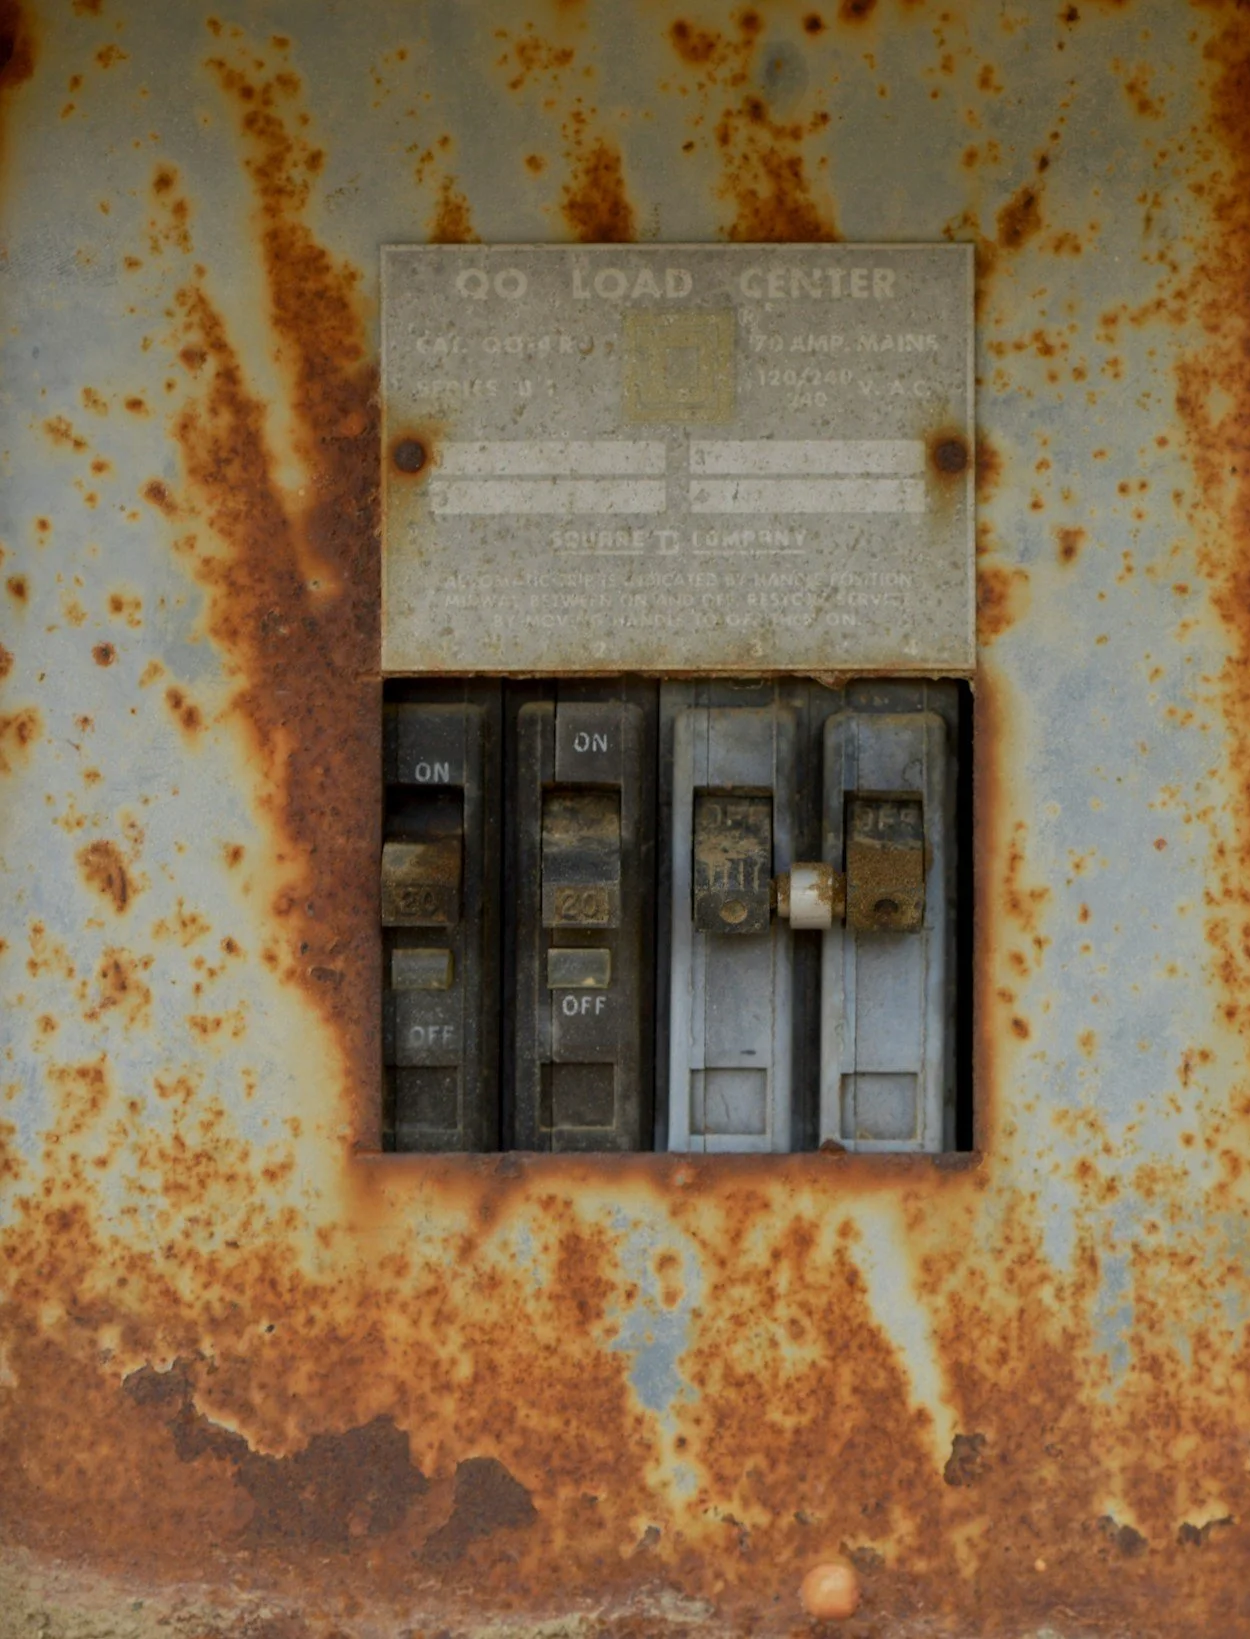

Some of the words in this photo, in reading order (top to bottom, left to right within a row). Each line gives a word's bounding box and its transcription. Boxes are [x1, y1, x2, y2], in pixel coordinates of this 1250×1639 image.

[456, 268, 529, 300] QO
[572, 268, 694, 300] LOAD
[739, 268, 897, 300] CENTER
[856, 334, 939, 353] MAINS
[549, 530, 645, 550] SQUARE
[573, 731, 608, 753] ON
[414, 762, 450, 783] ON
[560, 890, 598, 920] 20
[561, 995, 607, 1017] OFF
[409, 1025, 454, 1046] OFF
